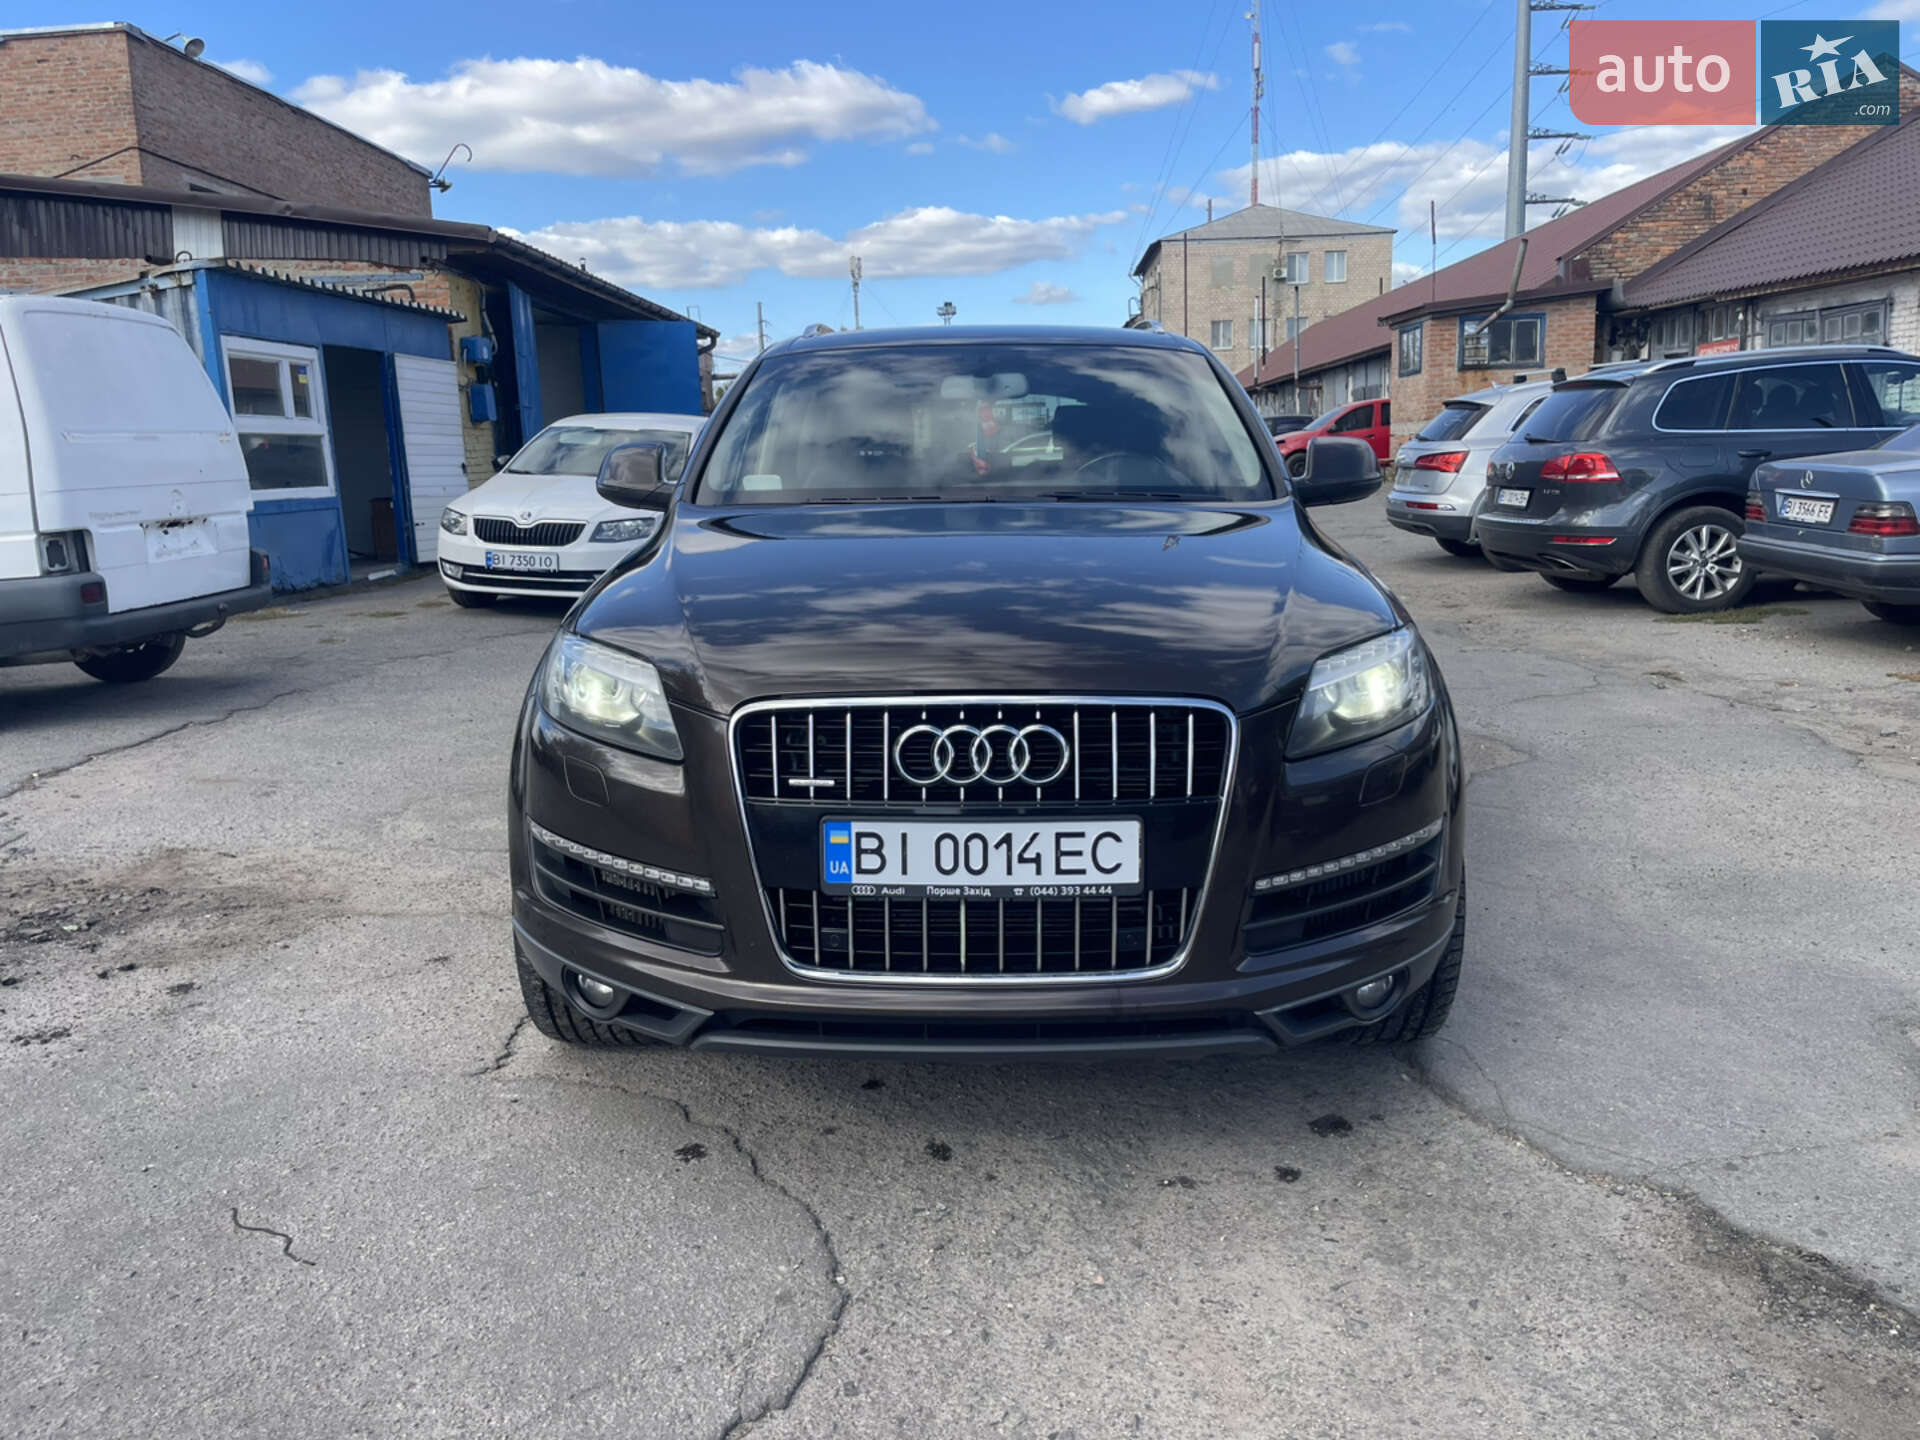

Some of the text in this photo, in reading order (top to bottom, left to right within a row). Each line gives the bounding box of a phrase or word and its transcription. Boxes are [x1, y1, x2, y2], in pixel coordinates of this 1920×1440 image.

[492, 554, 505, 566] BI
[510, 554, 536, 567] 7350
[830, 861, 849, 875] UA
[881, 887, 905, 895] Audi
[926, 886, 992, 896] Порше Захід
[1030, 886, 1112, 896] (044) 393 44 44
